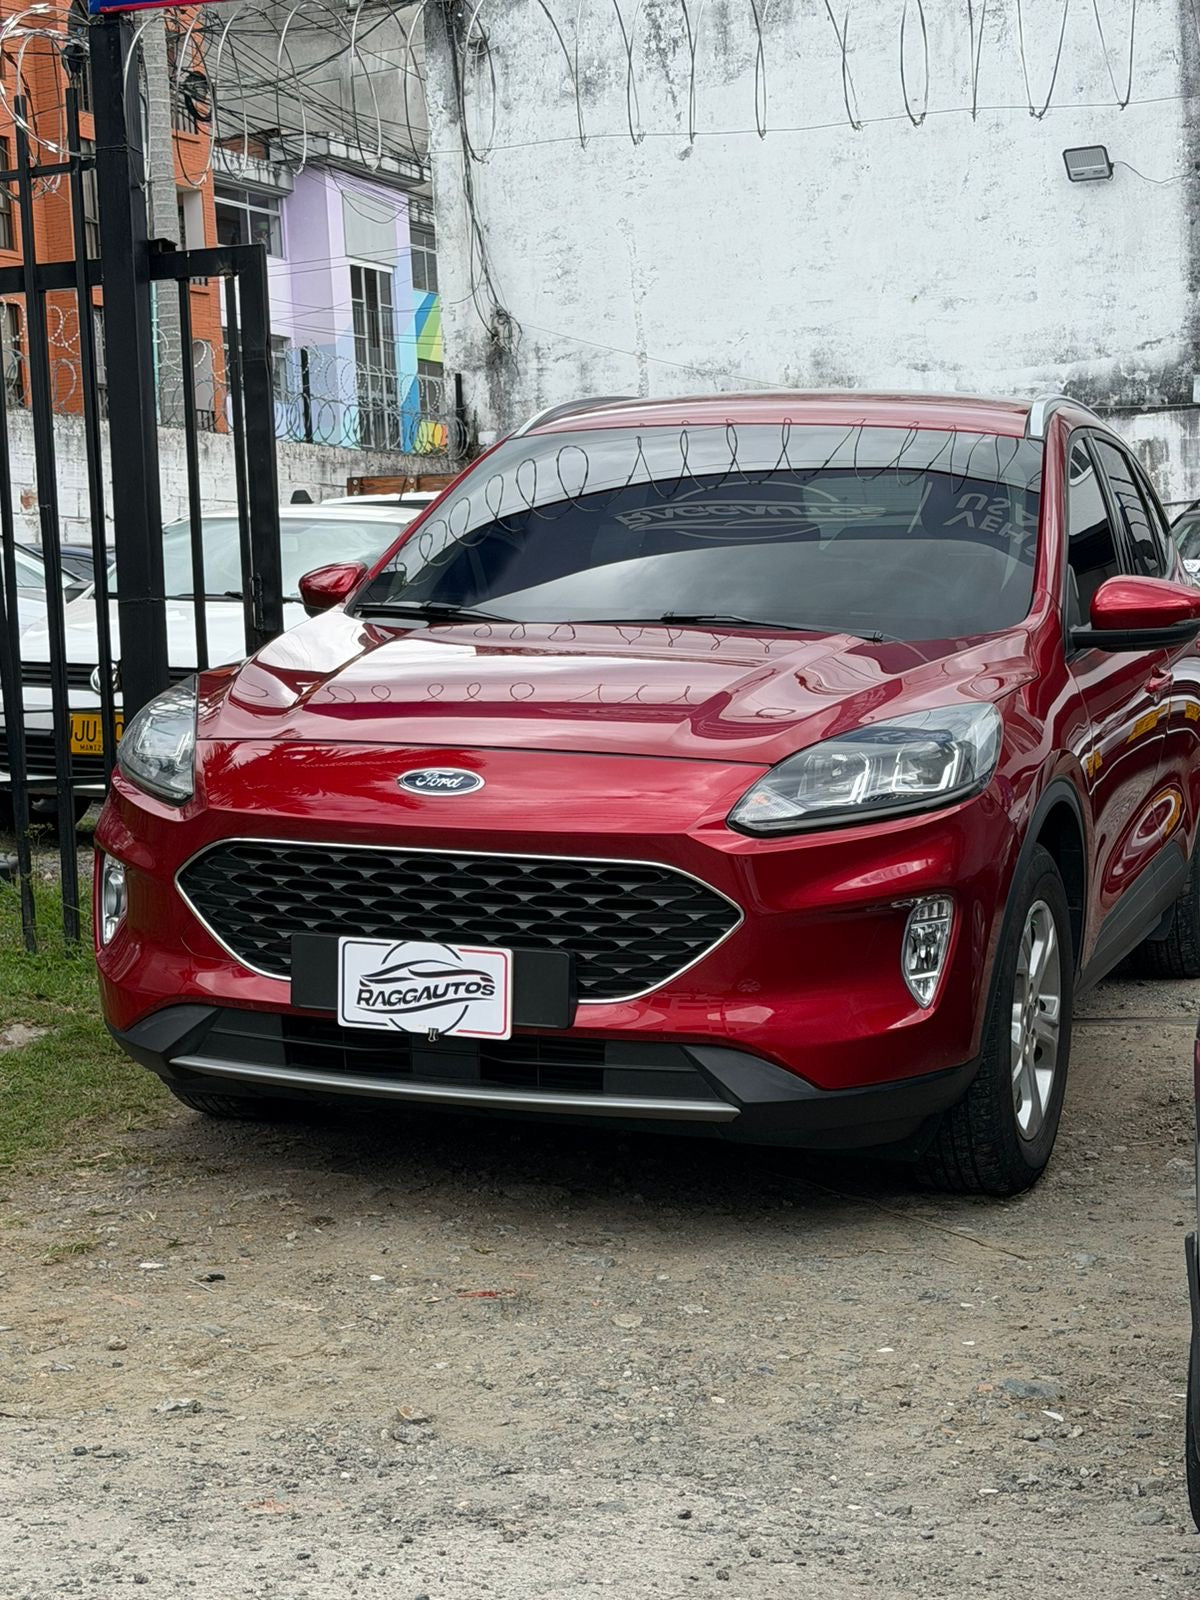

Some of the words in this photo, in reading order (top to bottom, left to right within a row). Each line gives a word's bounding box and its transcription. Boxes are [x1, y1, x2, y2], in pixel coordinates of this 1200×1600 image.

[70, 719, 97, 742] JU
[80, 743, 102, 752] MANIZ
[415, 770, 464, 788] Ford
[356, 981, 495, 1007] RAGGAUTOS
